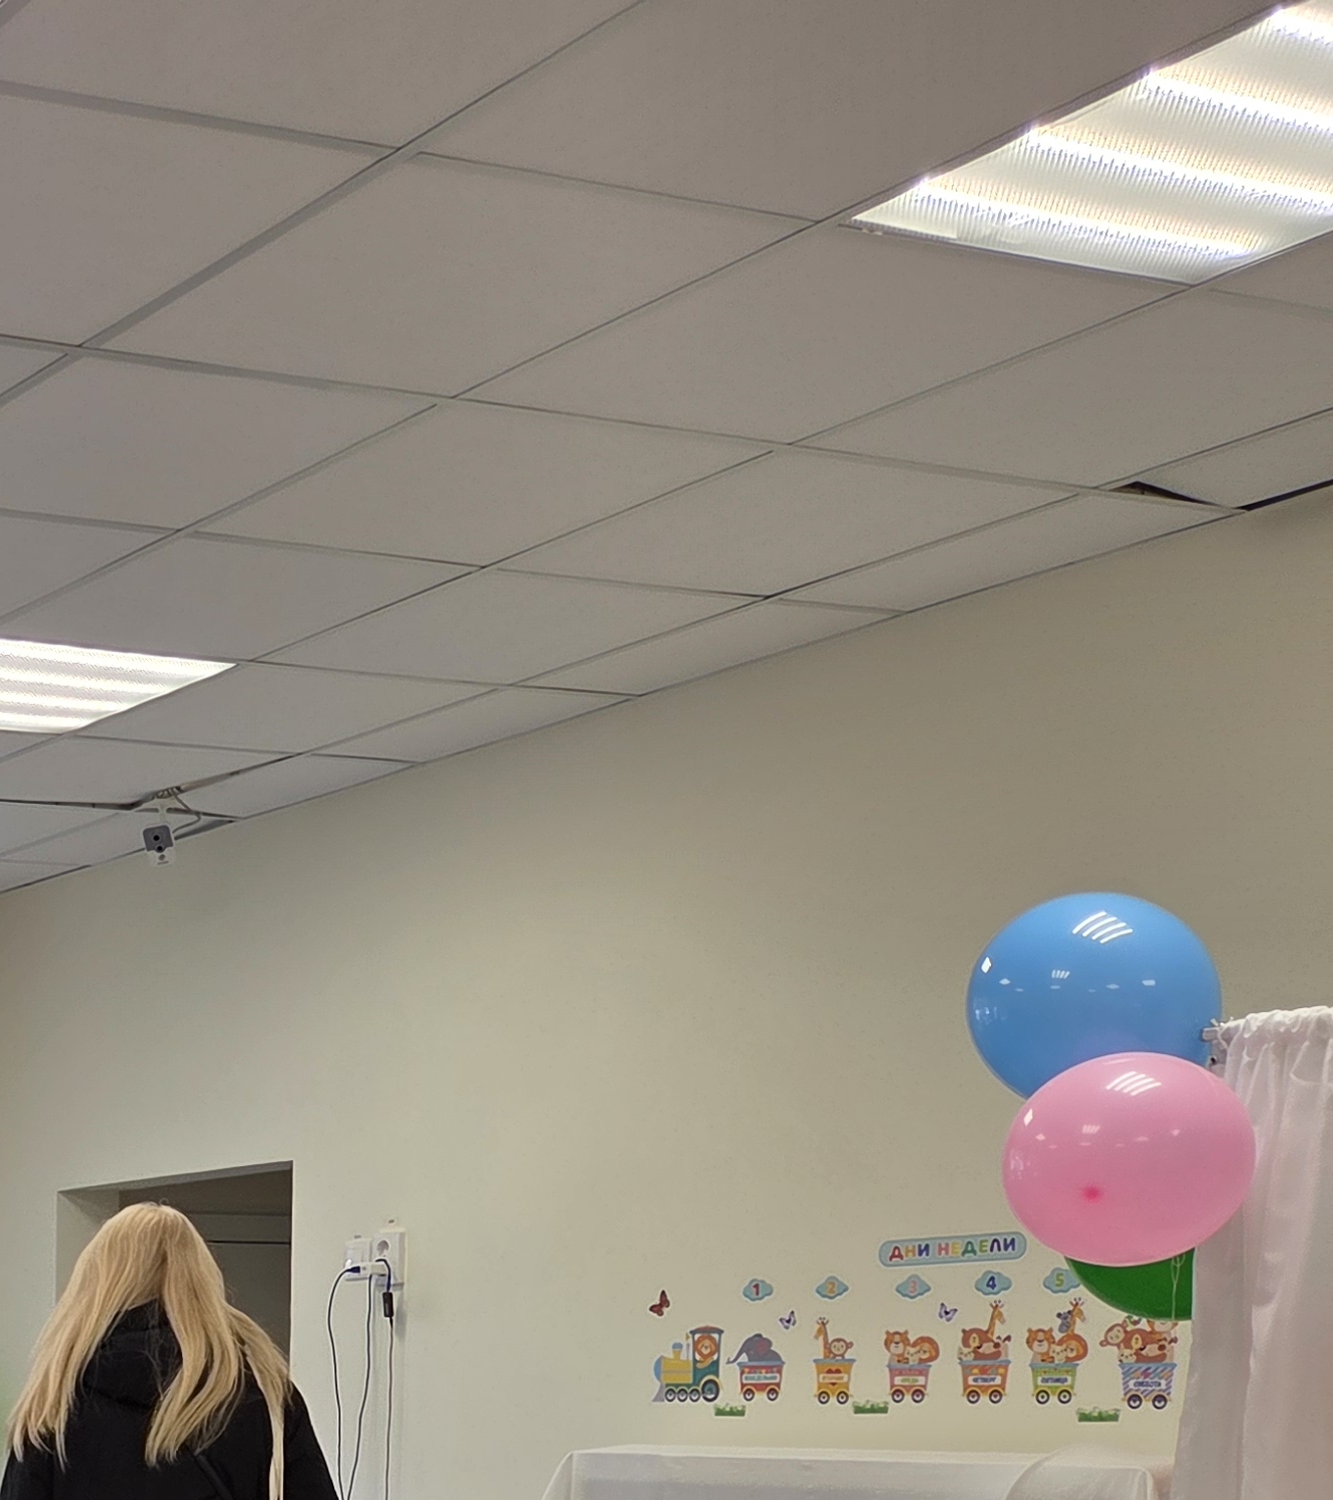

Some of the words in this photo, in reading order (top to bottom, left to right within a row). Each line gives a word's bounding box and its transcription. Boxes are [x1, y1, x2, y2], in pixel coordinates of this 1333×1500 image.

[888, 1242, 931, 1263] ДНИ
[937, 1237, 1017, 1258] НЕДЕЛИ
[824, 1280, 837, 1295] 2
[906, 1279, 919, 1295] 3
[985, 1274, 998, 1291] 4
[1054, 1271, 1065, 1288] 5
[751, 1283, 761, 1297] 1
